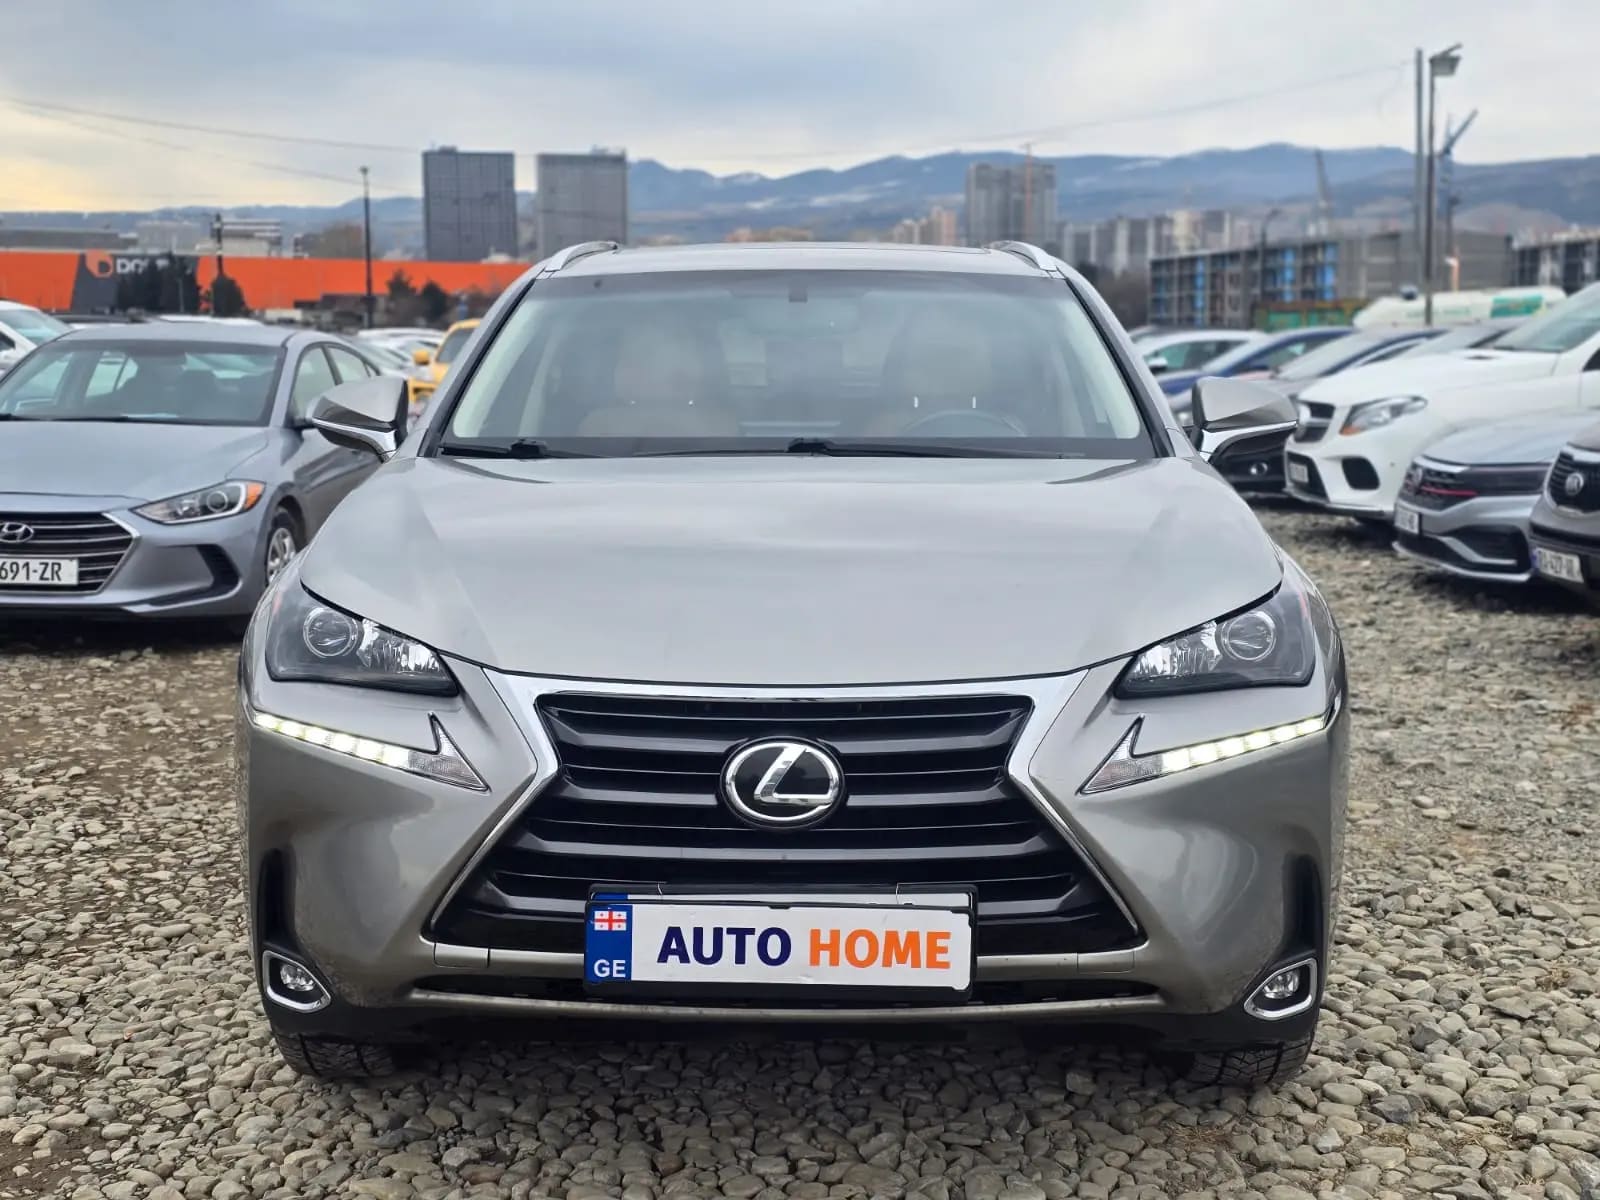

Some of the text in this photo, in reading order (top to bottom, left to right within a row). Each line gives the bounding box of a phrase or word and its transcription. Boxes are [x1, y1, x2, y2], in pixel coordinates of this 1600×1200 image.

[657, 926, 952, 969] AUTO HOME
[593, 959, 626, 978] GE
